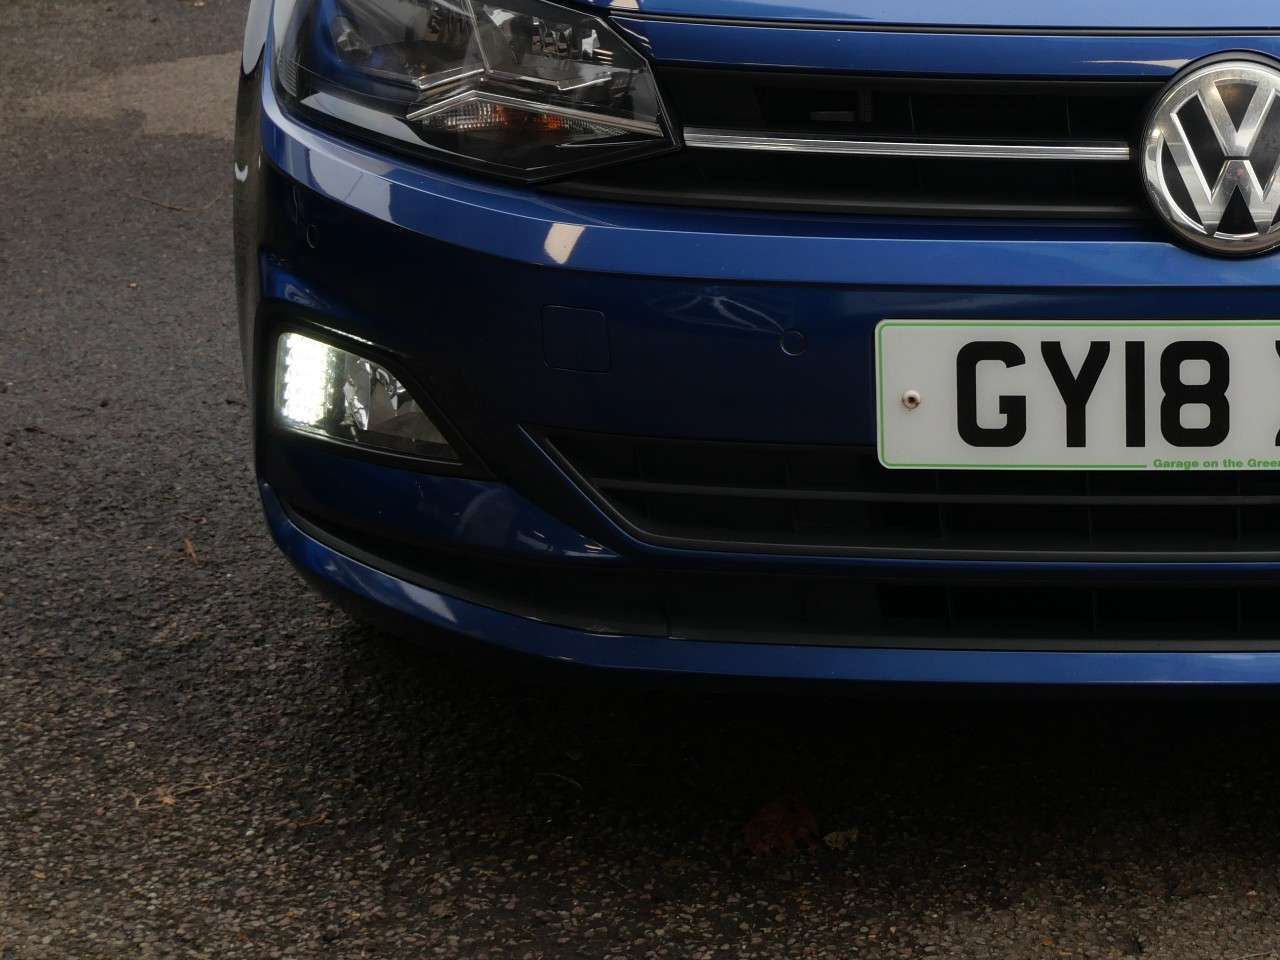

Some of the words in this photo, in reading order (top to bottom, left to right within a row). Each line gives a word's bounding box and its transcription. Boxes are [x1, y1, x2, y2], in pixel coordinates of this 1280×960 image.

[956, 340, 1230, 448] GY18
[1152, 458, 1200, 470] Garage
[1202, 460, 1219, 469] on
[1222, 458, 1244, 469] the
